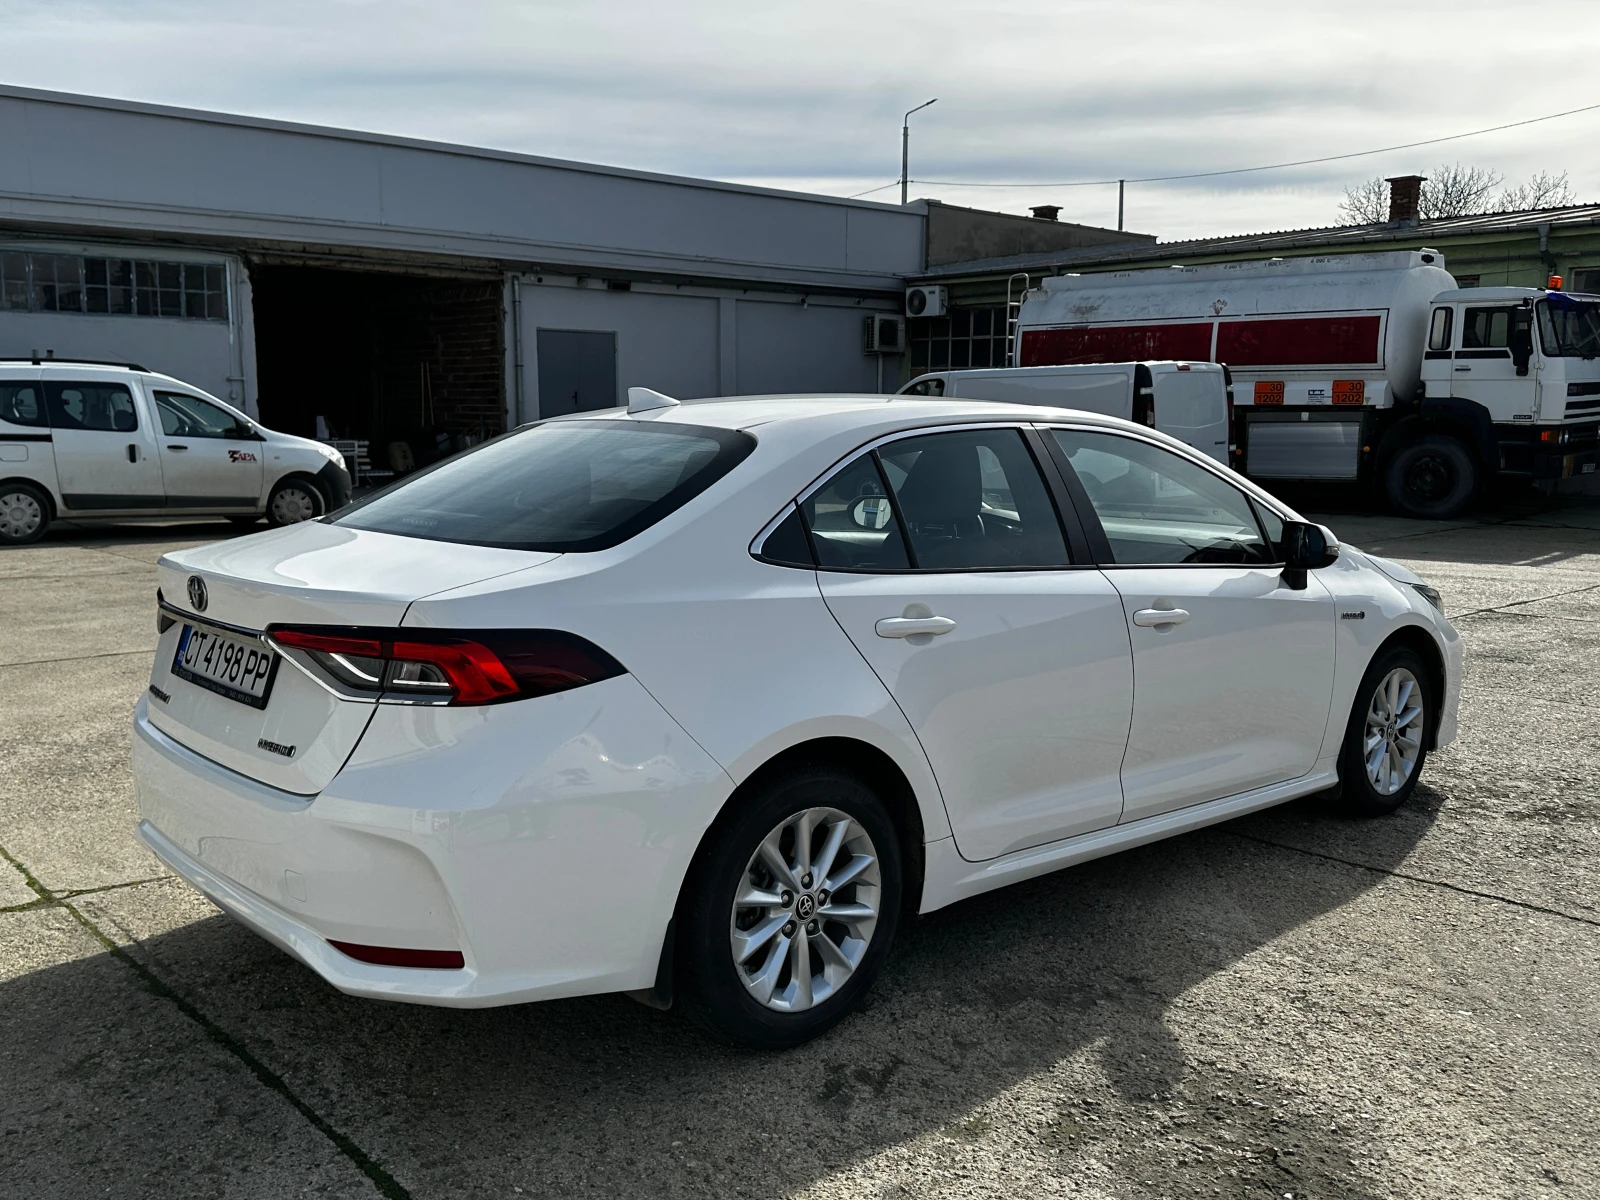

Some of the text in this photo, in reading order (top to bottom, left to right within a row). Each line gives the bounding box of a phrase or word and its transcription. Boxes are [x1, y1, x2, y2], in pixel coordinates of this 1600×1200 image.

[1269, 383, 1282, 392] 30
[1348, 382, 1362, 391] 30
[1257, 393, 1282, 403] 1202
[1336, 393, 1362, 403] 1202
[184, 630, 208, 667] CT
[203, 637, 244, 683] 4198
[240, 649, 270, 691] PP
